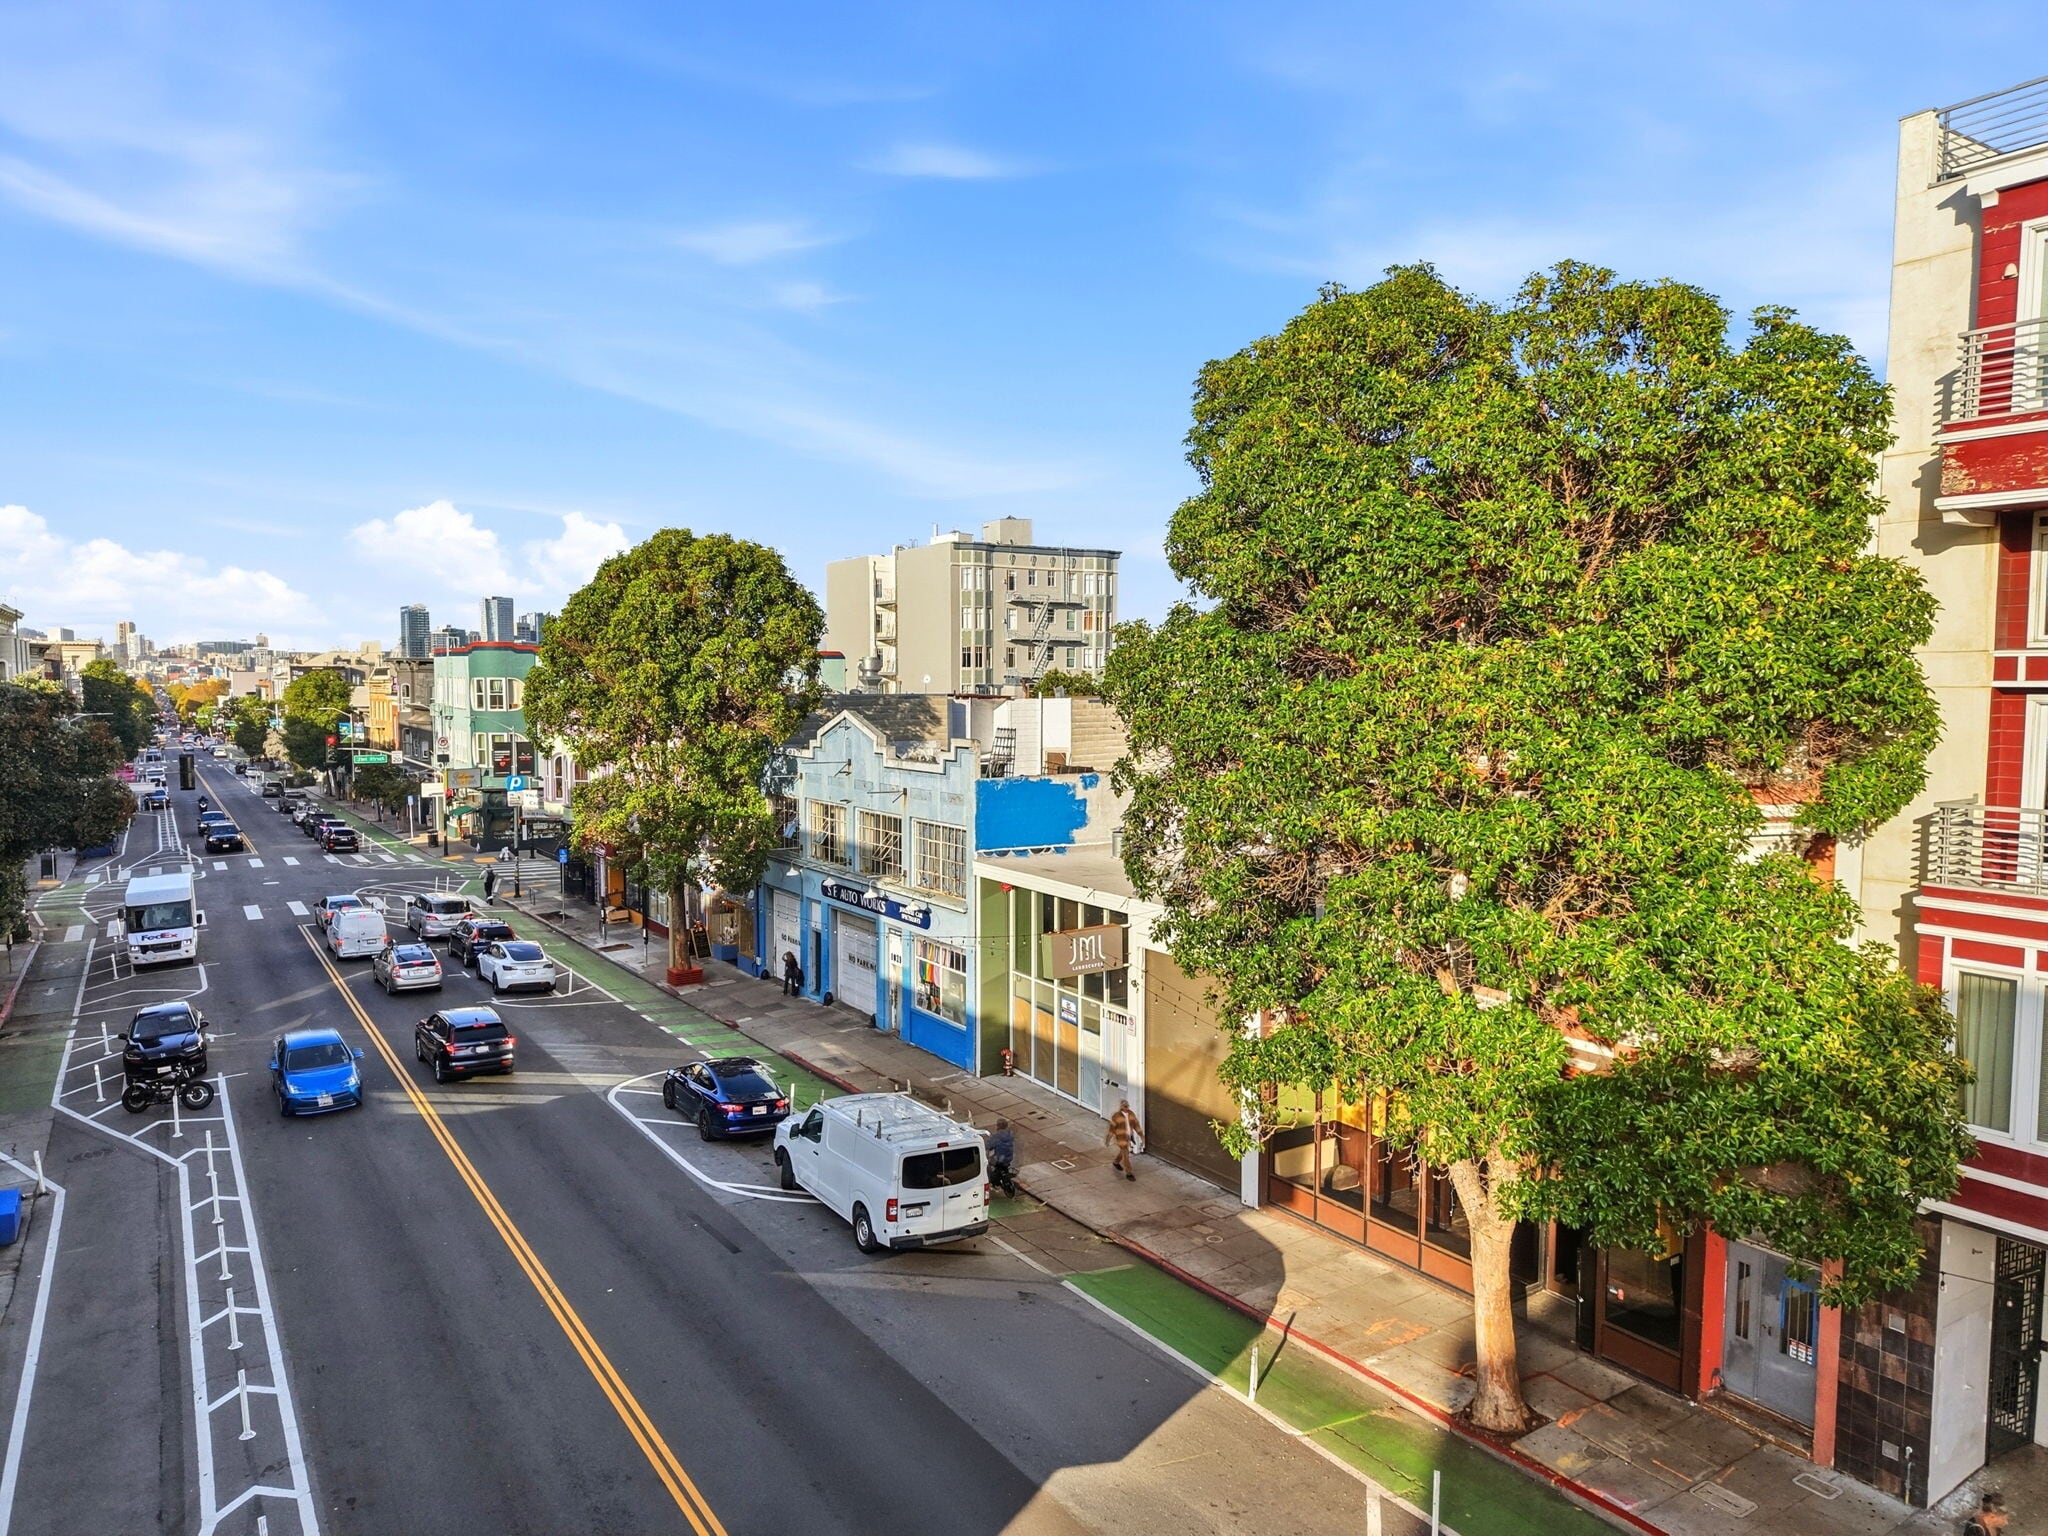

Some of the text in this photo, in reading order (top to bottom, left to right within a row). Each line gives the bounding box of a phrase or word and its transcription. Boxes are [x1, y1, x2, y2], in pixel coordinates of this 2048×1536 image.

[840, 888, 858, 904] AUTO
[860, 893, 886, 913] WORKS
[141, 932, 178, 941] FedEx
